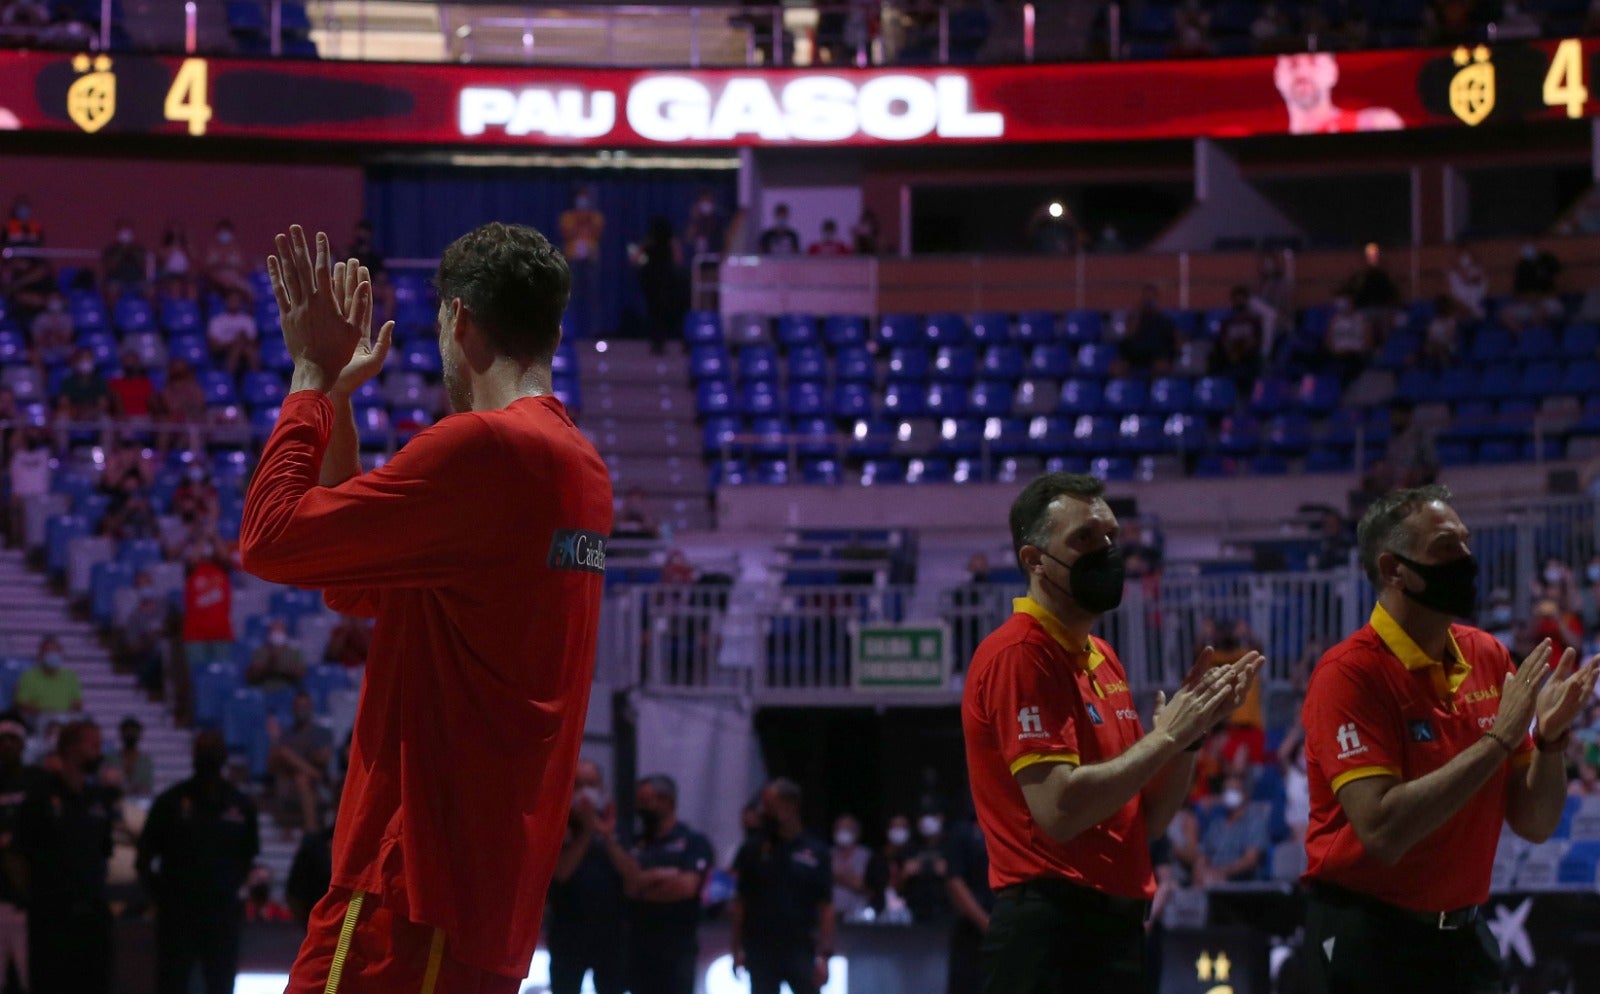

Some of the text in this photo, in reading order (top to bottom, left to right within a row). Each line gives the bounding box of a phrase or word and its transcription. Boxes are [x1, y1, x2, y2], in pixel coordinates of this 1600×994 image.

[163, 57, 213, 136] 4
[459, 74, 1004, 142] PAU GASOL
[1542, 38, 1588, 120] 4
[1017, 705, 1043, 732] fi
[1336, 721, 1361, 753] fi
